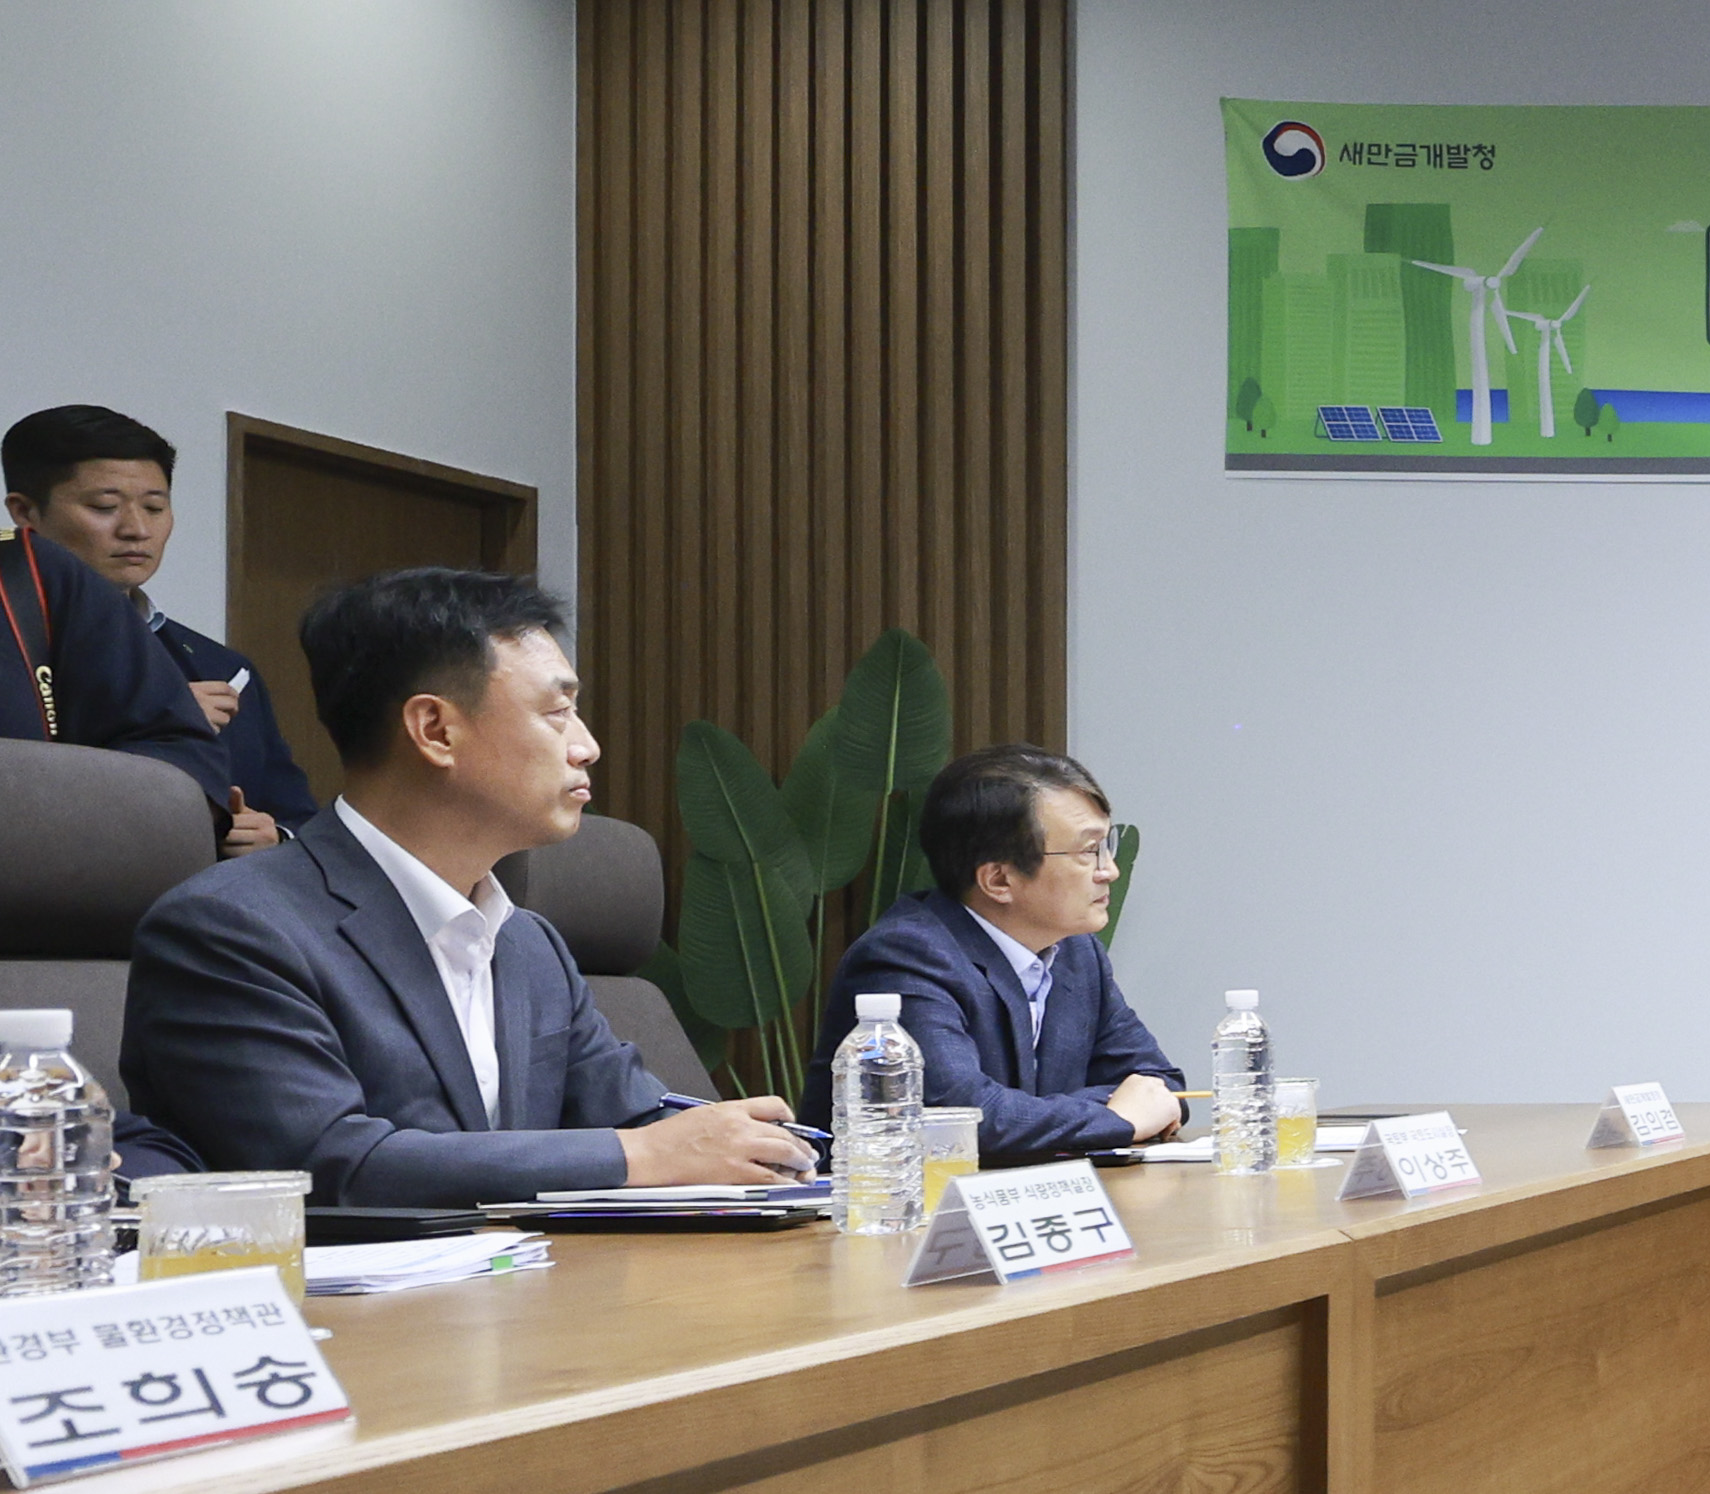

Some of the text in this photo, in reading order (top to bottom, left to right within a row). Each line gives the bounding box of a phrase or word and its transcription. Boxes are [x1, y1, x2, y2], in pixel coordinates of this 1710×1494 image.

[1339, 142, 1496, 170] 새만금개발청
[1398, 1148, 1469, 1183] 이상주
[968, 1176, 1096, 1211] 농식품부 식량정책실장
[986, 1206, 1115, 1262] 김종구
[92, 1301, 287, 1350] 물환경정책관
[11, 1355, 318, 1449] 조희송
